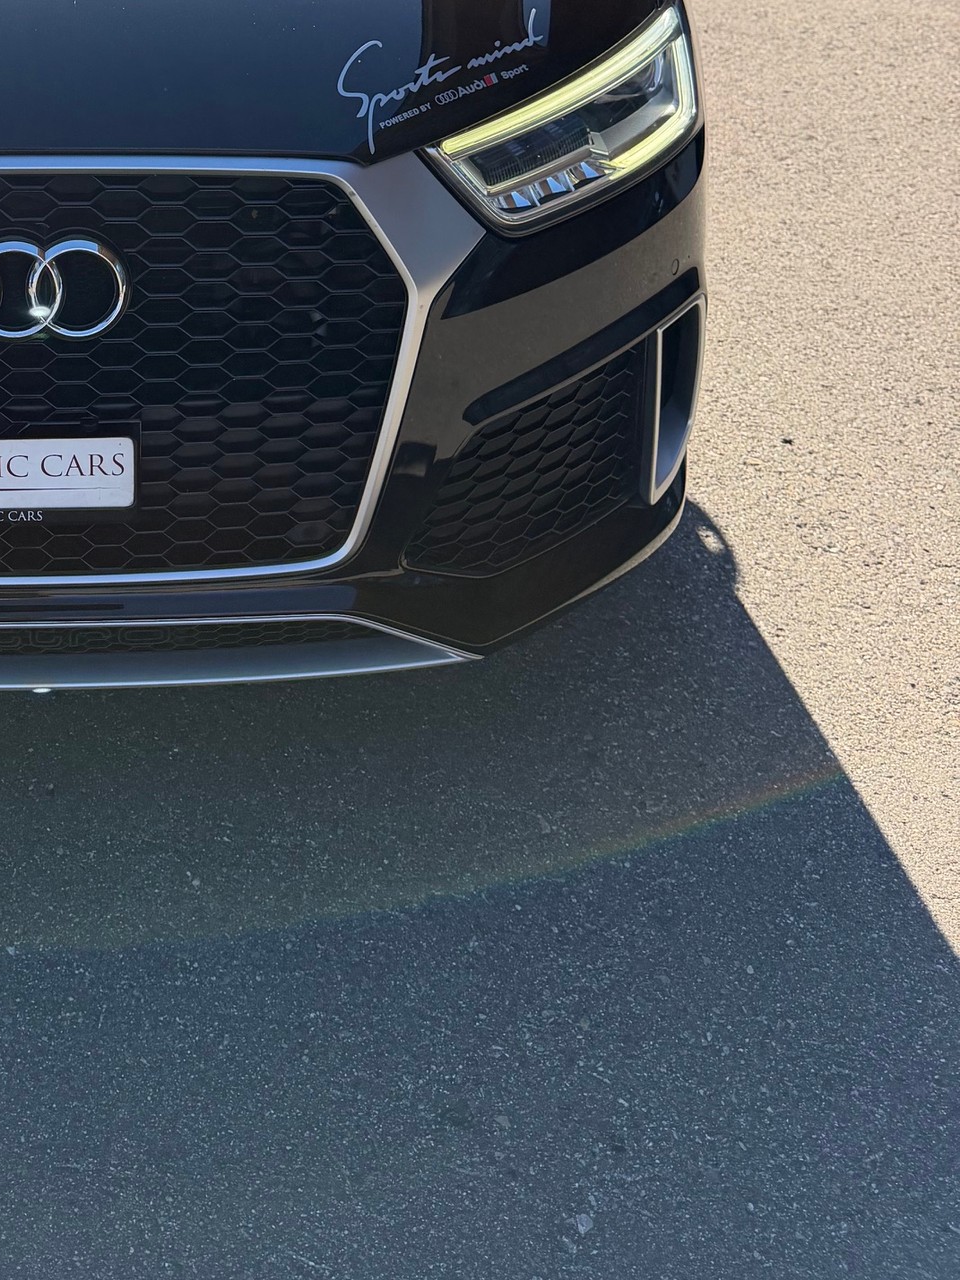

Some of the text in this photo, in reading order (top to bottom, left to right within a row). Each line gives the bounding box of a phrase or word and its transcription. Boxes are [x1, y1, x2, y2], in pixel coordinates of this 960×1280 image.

[378, 64, 530, 130] POWERED BY Audi Sport
[40, 452, 126, 477] CARS
[7, 510, 44, 522] CARS
